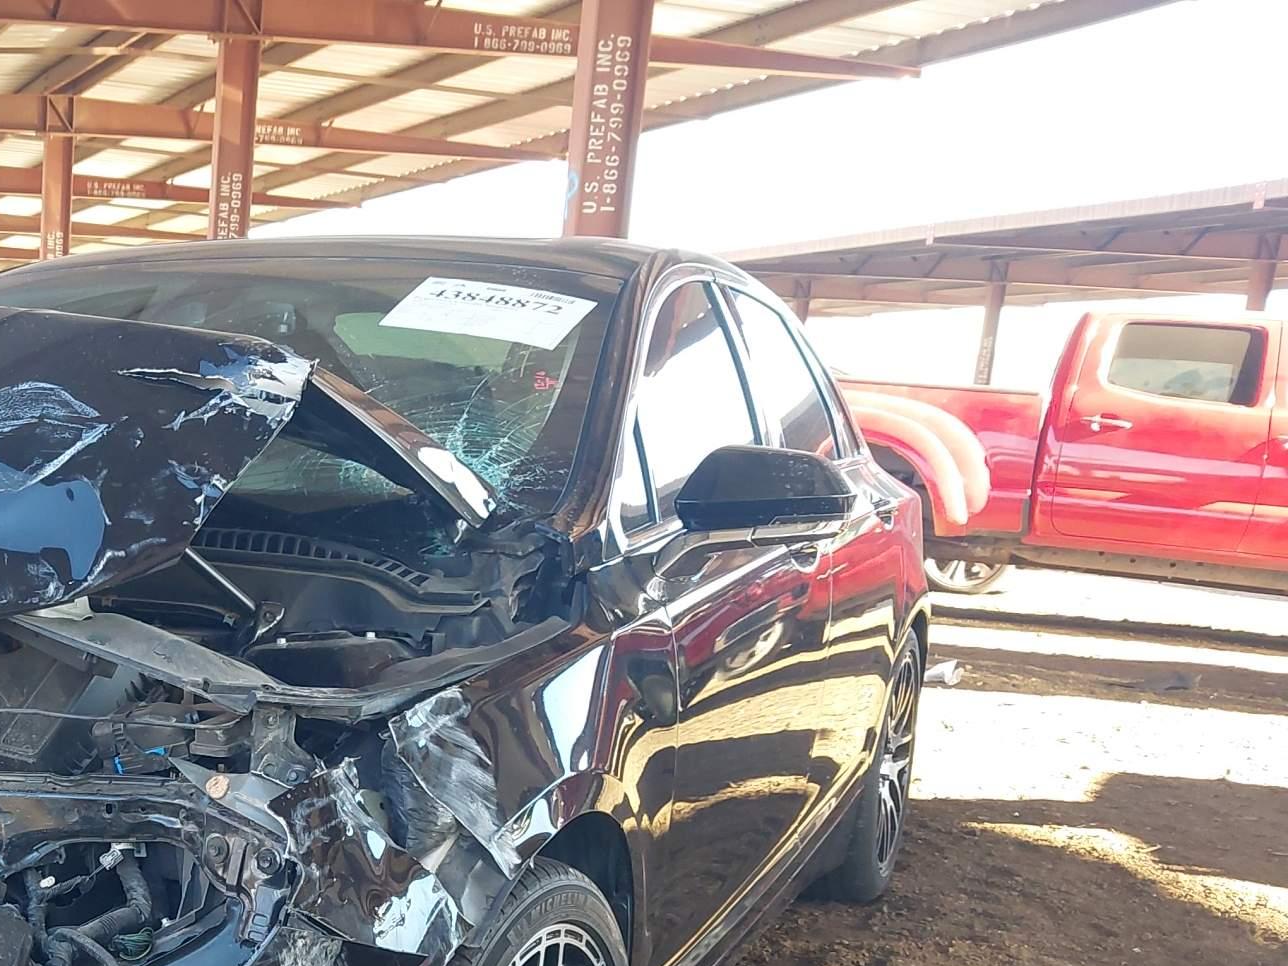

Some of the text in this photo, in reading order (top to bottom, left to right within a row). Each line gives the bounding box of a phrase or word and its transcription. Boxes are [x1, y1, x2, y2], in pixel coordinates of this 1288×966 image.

[474, 22, 496, 37] U.S.
[501, 25, 547, 40] PREFAB
[582, 33, 615, 214] U.S. PREFAB INC.
[600, 35, 632, 212] 1-866-799-0969
[430, 288, 563, 315] 43848872
